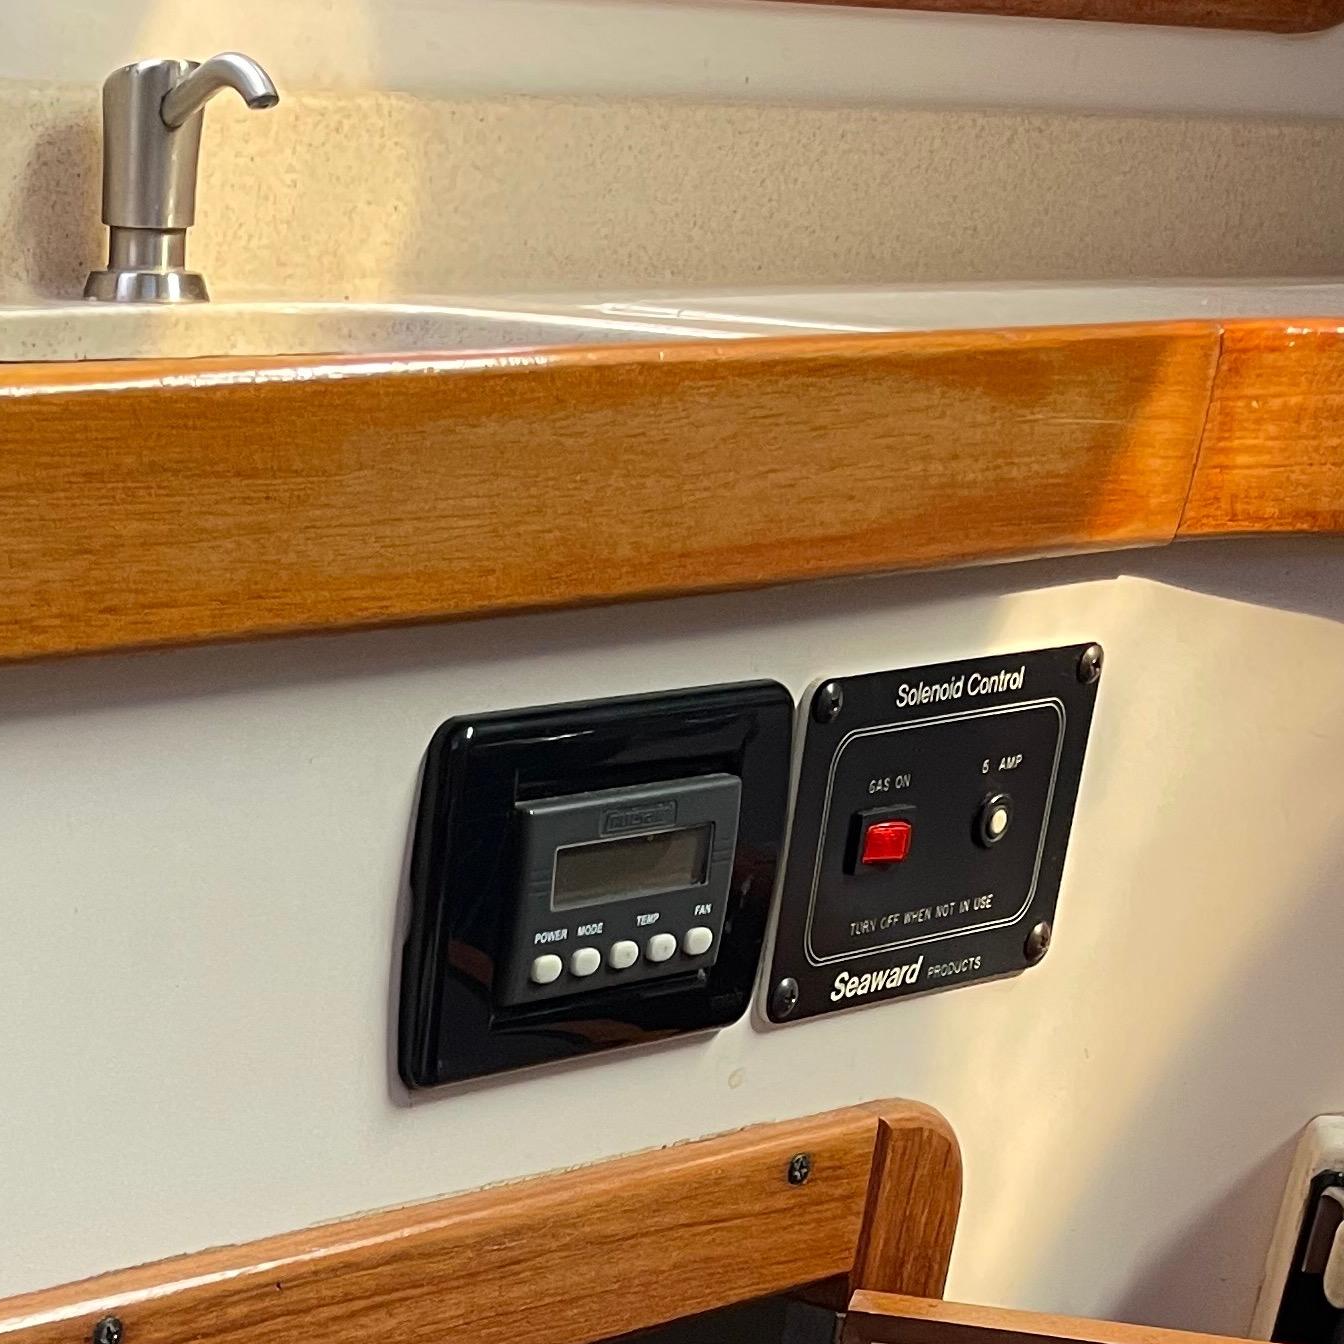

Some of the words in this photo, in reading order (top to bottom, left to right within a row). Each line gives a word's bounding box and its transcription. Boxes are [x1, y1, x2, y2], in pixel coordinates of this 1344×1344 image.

[896, 674, 965, 708] Solenoid
[967, 665, 1025, 696] Control
[998, 754, 1023, 771] AMP
[868, 777, 890, 794] GAS
[895, 773, 911, 789] ON
[636, 912, 660, 926] TEMP
[694, 903, 713, 916] FAN
[849, 919, 877, 937] TURN
[880, 913, 899, 930] OFF
[903, 906, 932, 925] WHEN
[935, 902, 956, 919] NOT
[959, 898, 971, 913] IN
[973, 893, 994, 911] USE
[534, 928, 568, 944] POWER
[577, 922, 603, 937] MODE
[830, 955, 924, 1002] Seaward
[927, 955, 982, 980] PRODUCTS
